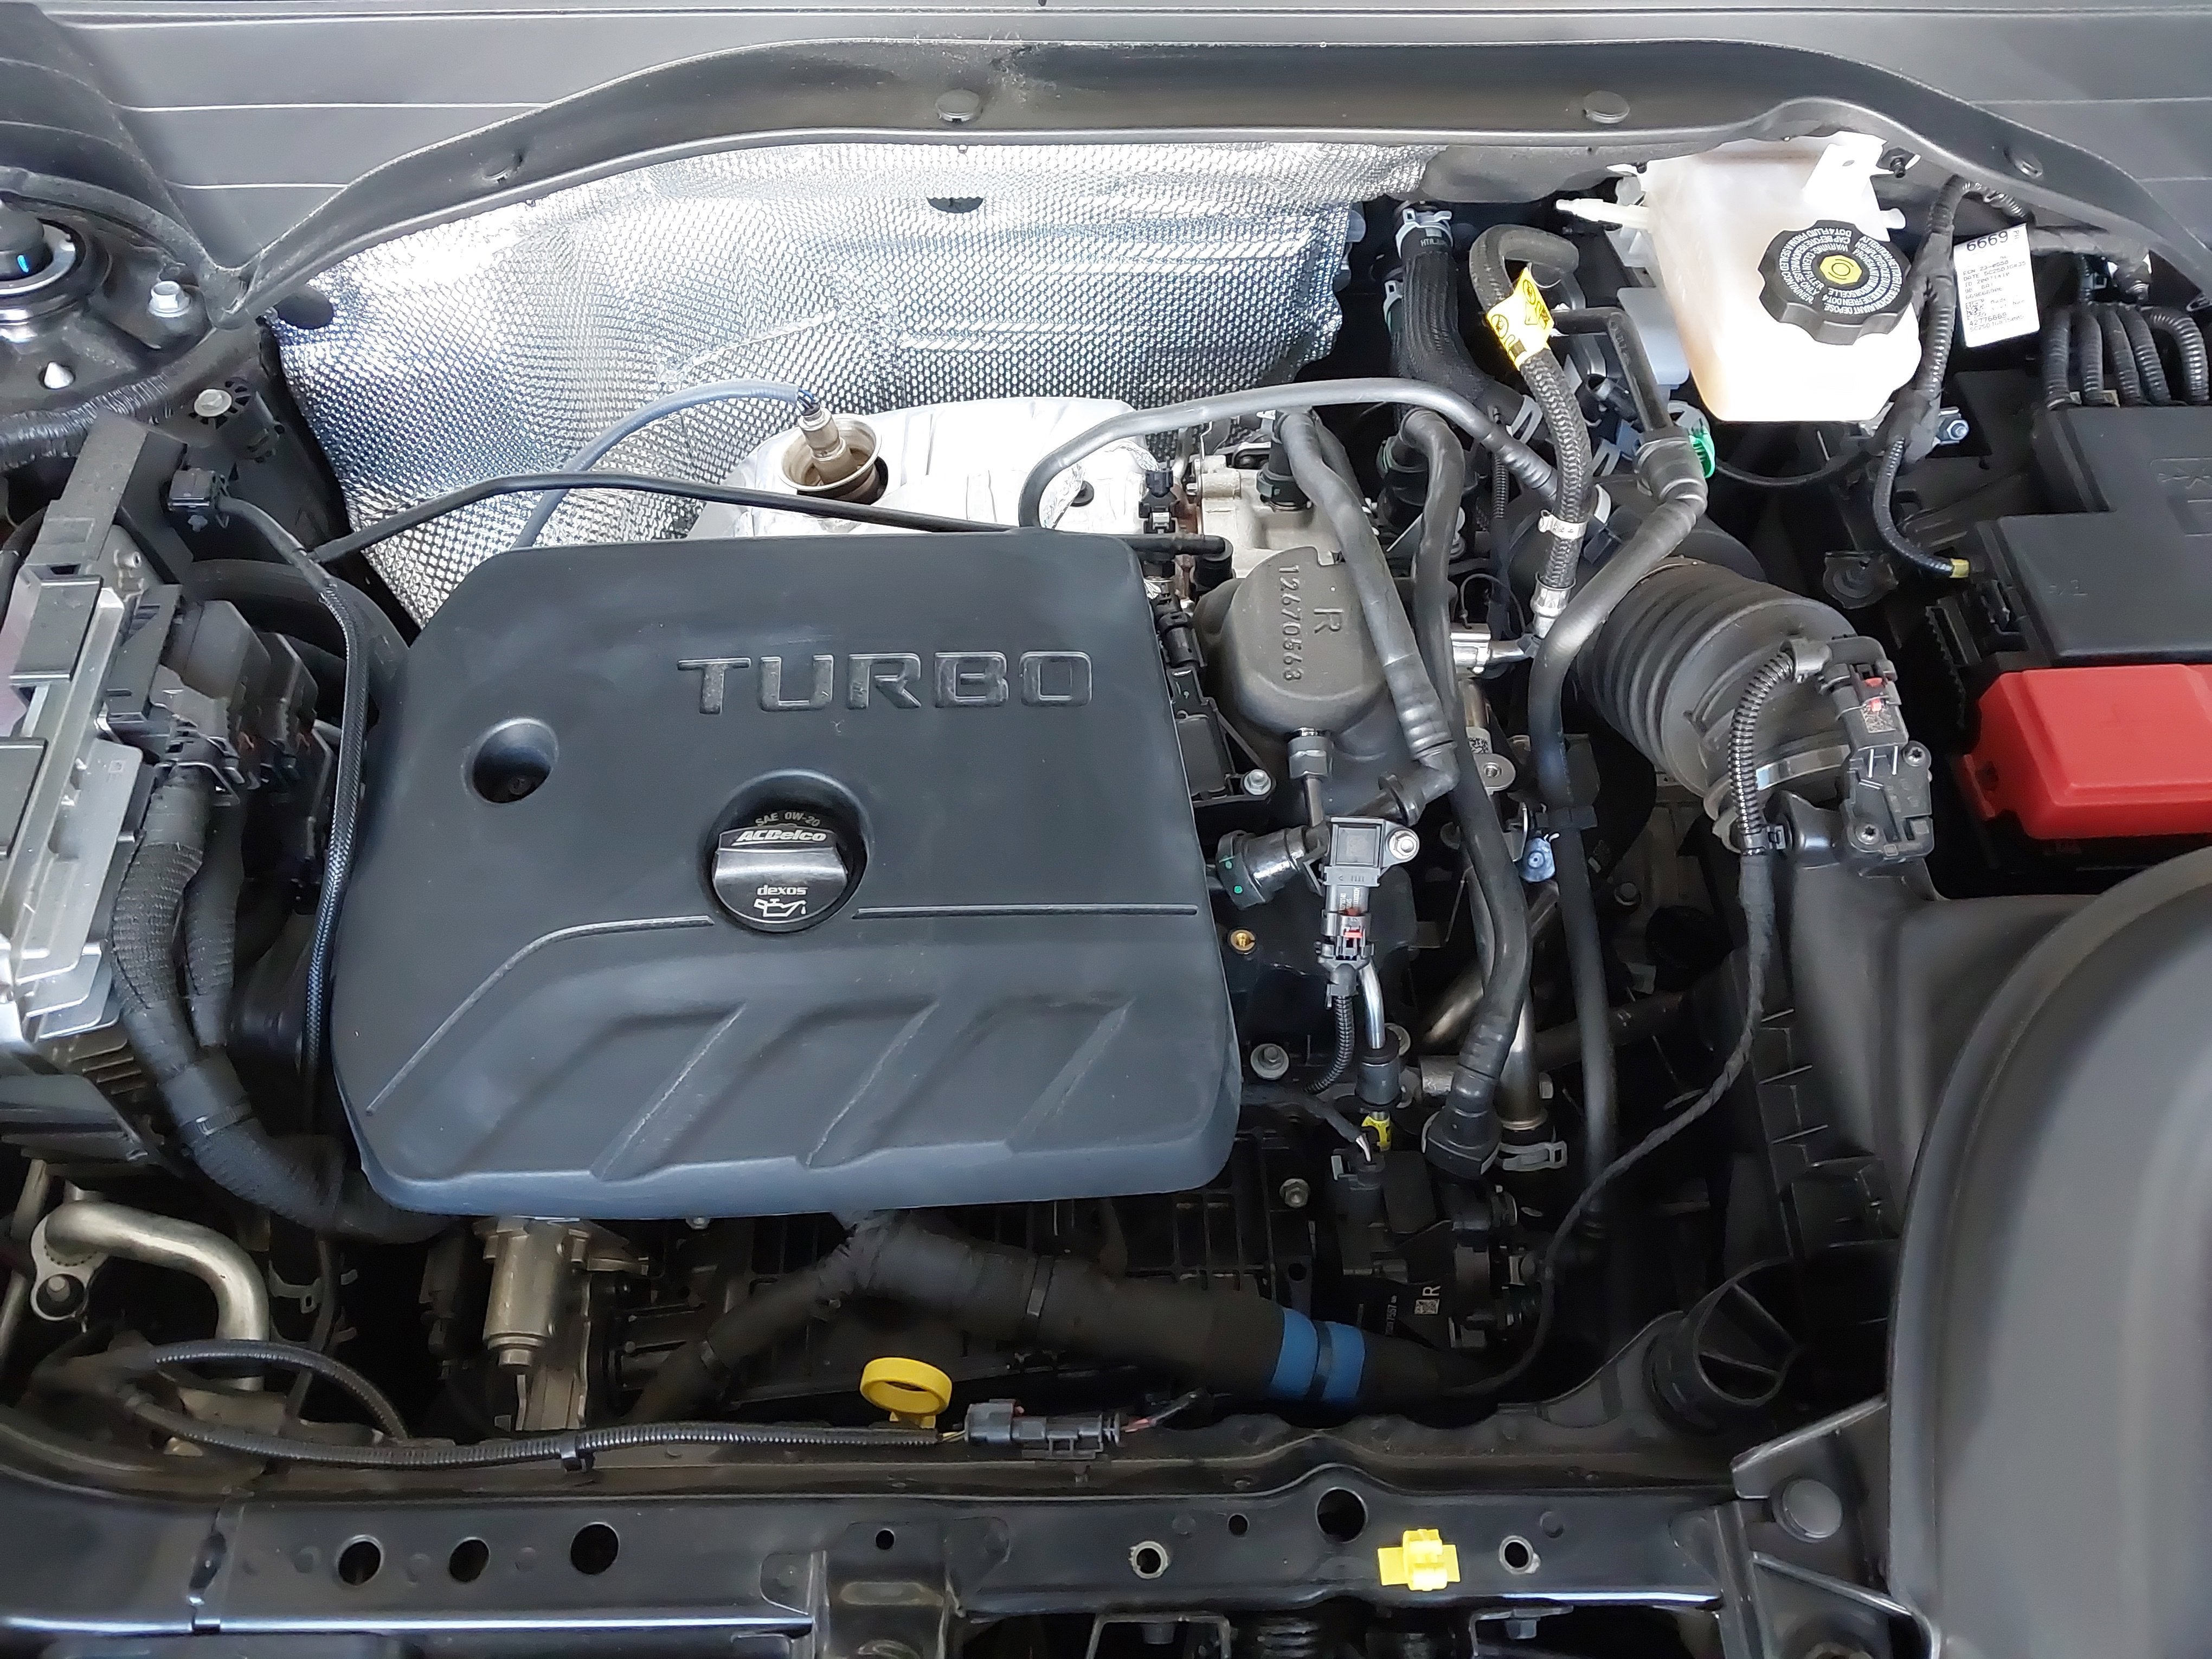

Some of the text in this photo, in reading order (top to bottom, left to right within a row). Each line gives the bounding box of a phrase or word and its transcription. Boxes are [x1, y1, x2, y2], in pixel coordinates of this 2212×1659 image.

[1967, 231, 2008, 251] 6669
[1779, 248, 1791, 271] SEALED
[1802, 252, 1816, 270] CLEAN
[1792, 270, 1805, 282] USE
[1801, 280, 1820, 296] ONLY
[1803, 271, 1824, 290] FILLER
[1828, 296, 1842, 305] DOT
[1279, 565, 1304, 680] 12670563
[1313, 608, 1344, 633] R
[677, 651, 1093, 715] TURBO
[755, 812, 820, 827] SAE 0W-20
[735, 829, 827, 842] ACDelco
[757, 884, 808, 896] dexos
